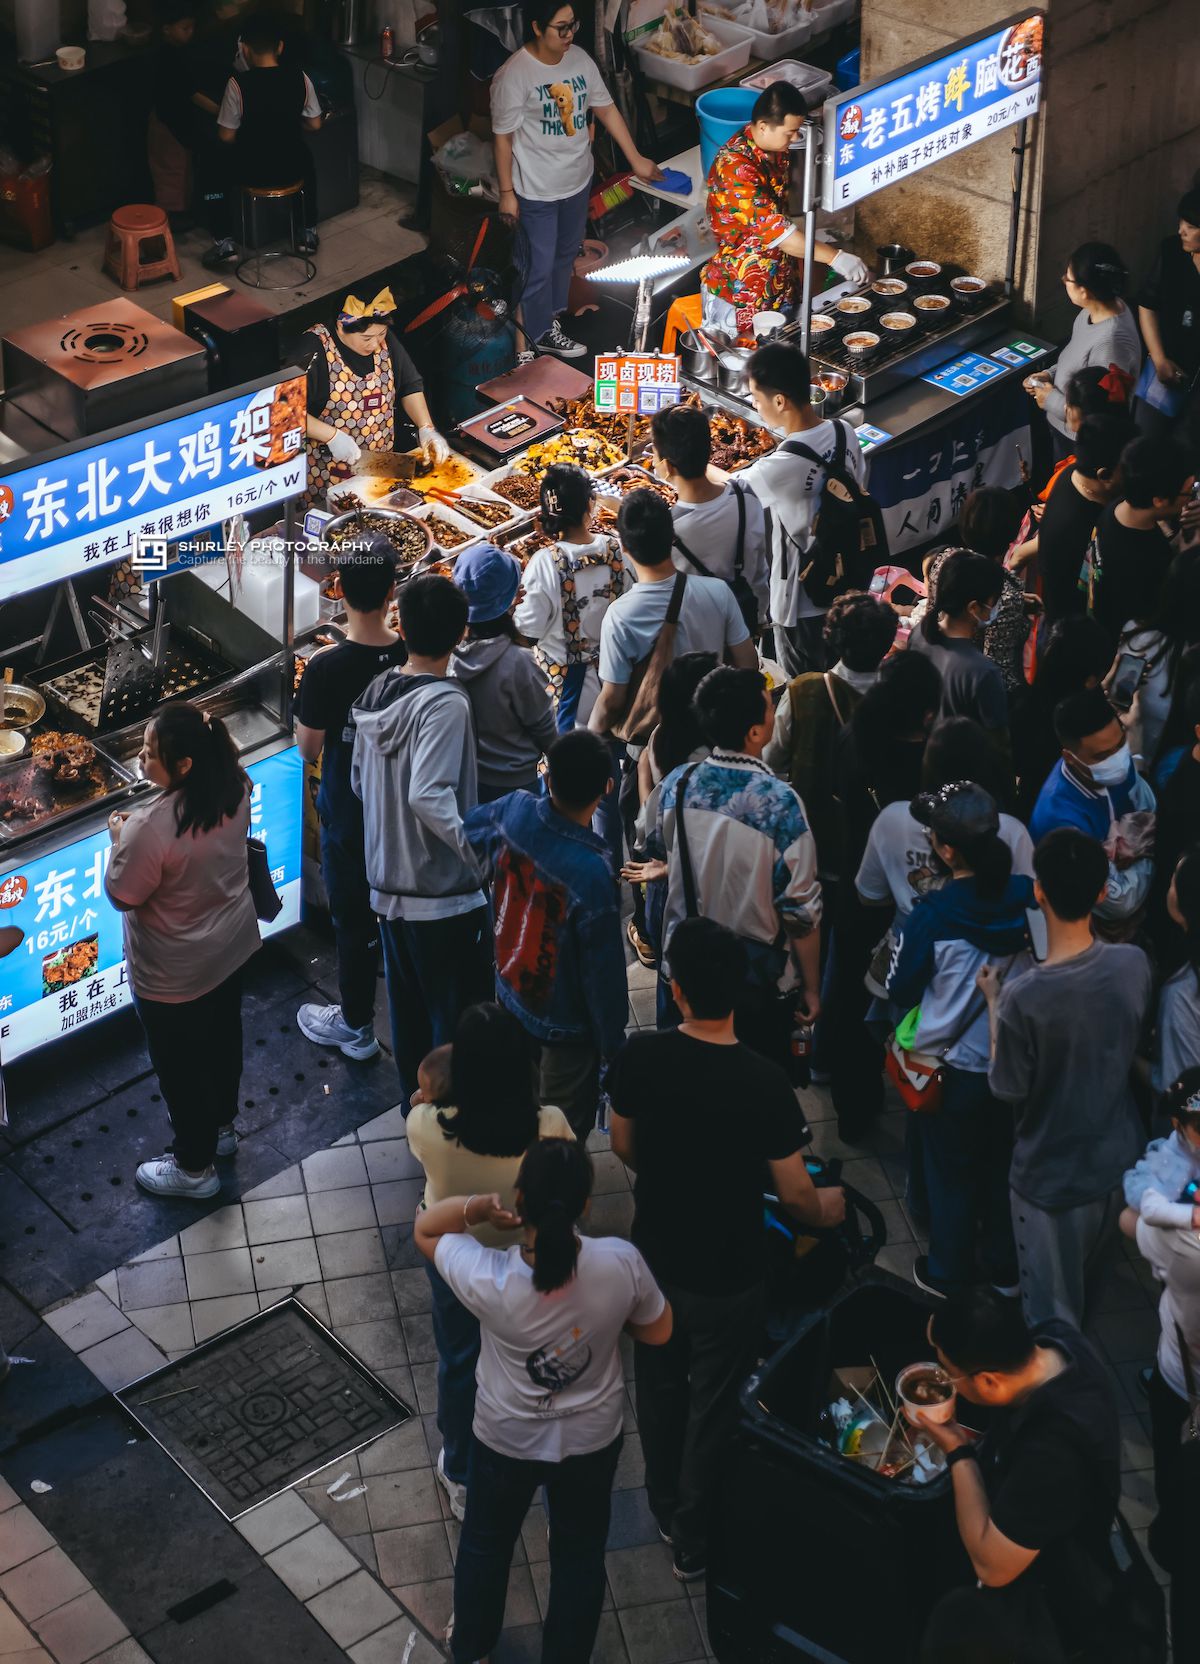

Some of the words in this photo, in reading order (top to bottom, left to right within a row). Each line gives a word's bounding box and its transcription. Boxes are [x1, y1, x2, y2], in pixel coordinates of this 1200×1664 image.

[1026, 54, 1041, 78] 西
[861, 42, 1025, 149] 老五烤鲜脑花
[1026, 94, 1037, 107] W
[839, 143, 855, 165] 东
[871, 123, 973, 185] 补补脑子好找对象
[987, 102, 1020, 127] 20元/个
[842, 182, 849, 199] E
[600, 361, 675, 383] 现卤现捞
[283, 426, 302, 454] 西
[22, 406, 271, 541] 东北大鸡架
[283, 472, 300, 488] W
[84, 503, 211, 562] 我在上海很想你
[227, 481, 278, 509] 16元/个
[25, 907, 98, 954] 16元/个
[1, 1025, 10, 1038] E
